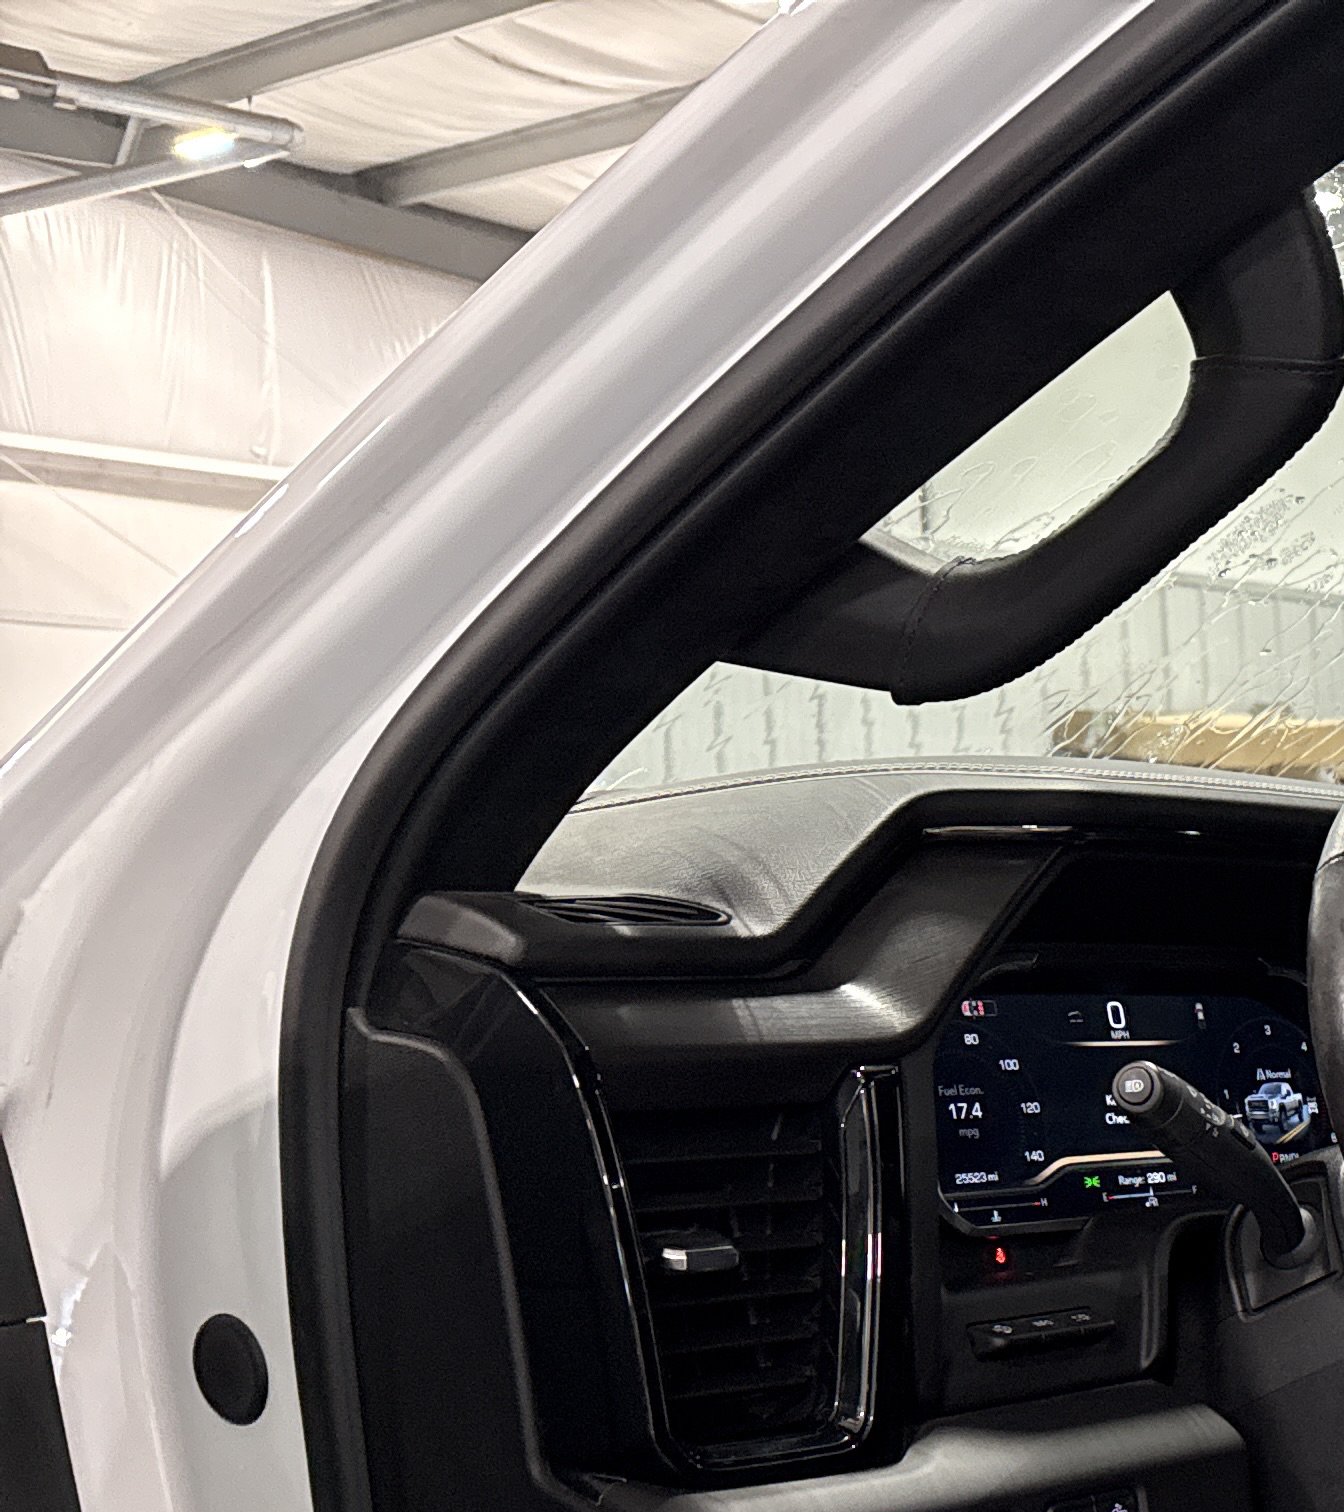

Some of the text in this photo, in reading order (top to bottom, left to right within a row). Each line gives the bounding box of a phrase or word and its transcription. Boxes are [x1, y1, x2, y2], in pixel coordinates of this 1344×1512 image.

[1107, 1001, 1126, 1029] 0
[1110, 1029, 1130, 1040] MPH
[1264, 1024, 1271, 1036] 3
[963, 1033, 979, 1045] 80
[1233, 1042, 1240, 1054] 2
[1301, 1041, 1308, 1052] 4
[999, 1058, 1020, 1071] 100
[1265, 1068, 1292, 1080] Normal
[938, 1084, 985, 1097] Fuel Econ.
[948, 1102, 983, 1120] 17.4
[1020, 1101, 1041, 1114] 120
[958, 1127, 980, 1140] mpg
[1024, 1150, 1045, 1163] 140
[954, 1170, 999, 1185] 25523 mi
[1118, 1171, 1178, 1187] Range: 290 mi
[1040, 1198, 1048, 1207] H
